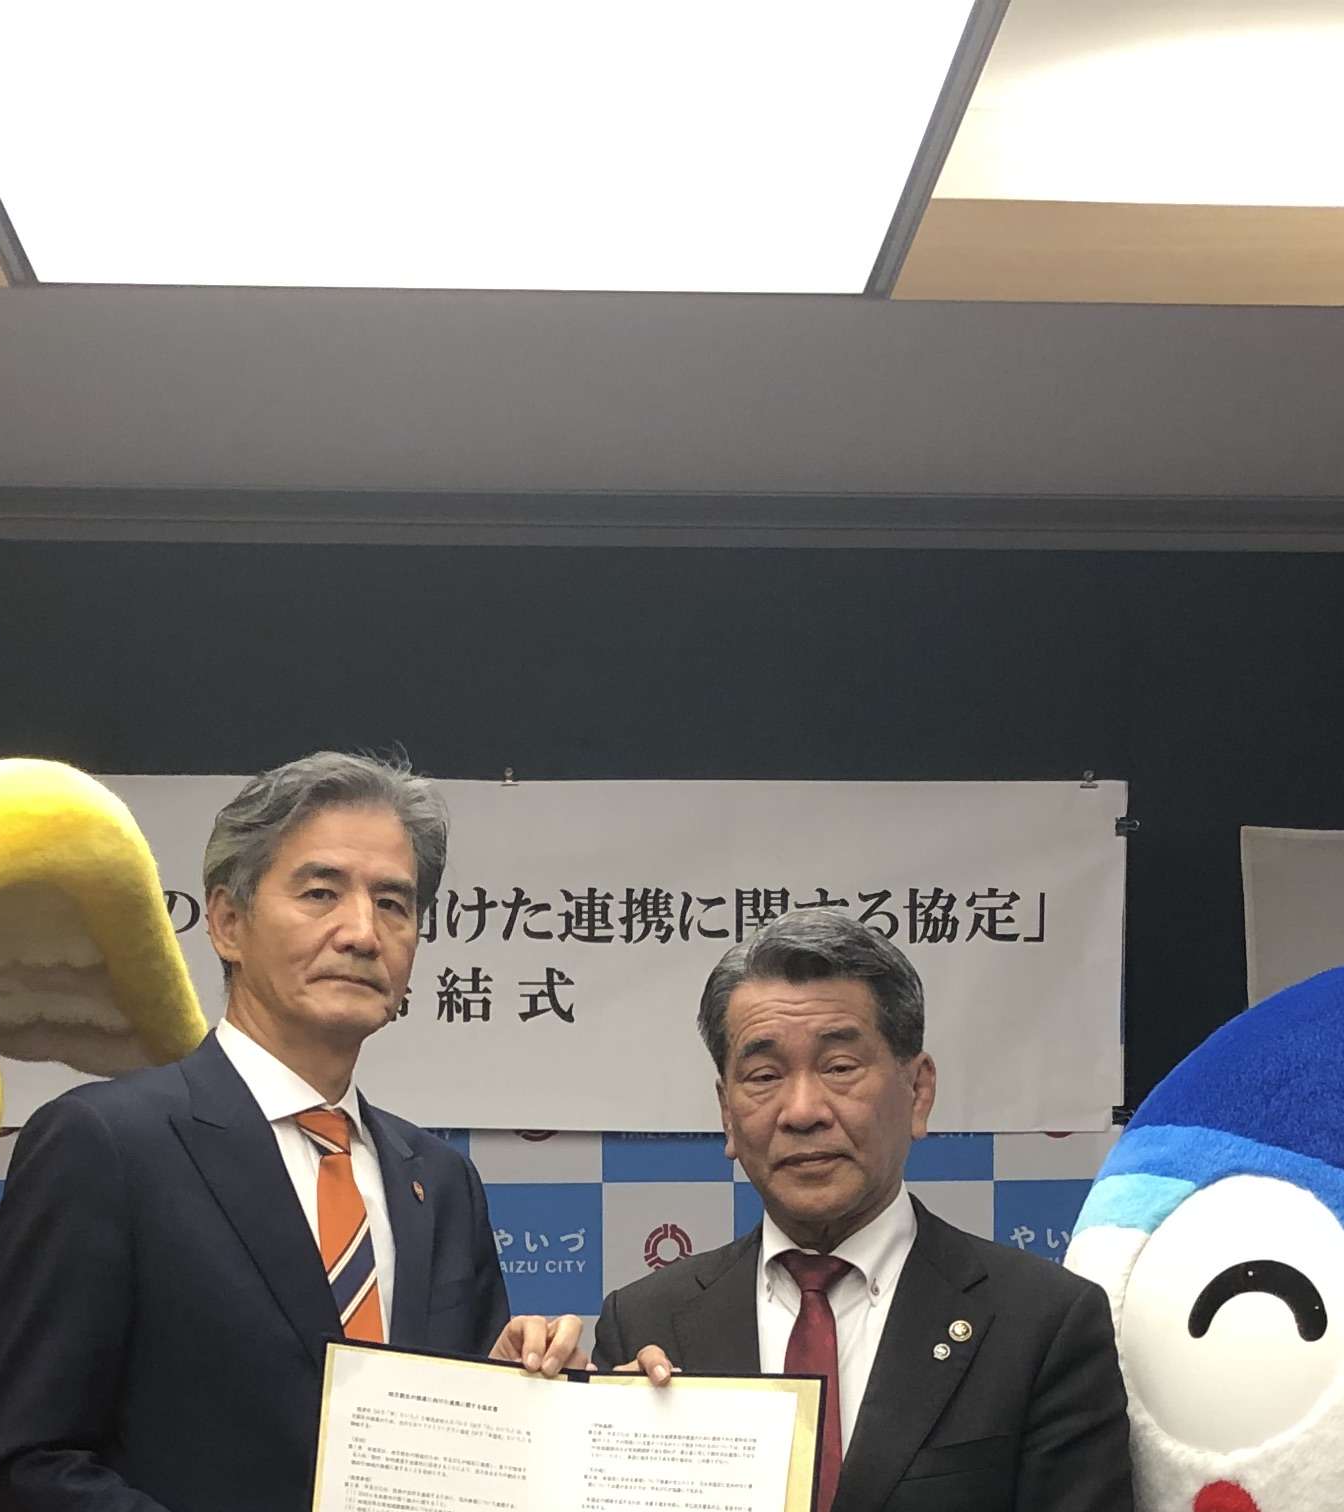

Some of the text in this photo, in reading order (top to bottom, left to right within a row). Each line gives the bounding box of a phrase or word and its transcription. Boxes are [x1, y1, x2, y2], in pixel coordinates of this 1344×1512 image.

[493, 1228, 586, 1255] やいづ
[545, 1260, 586, 1273] CITY
